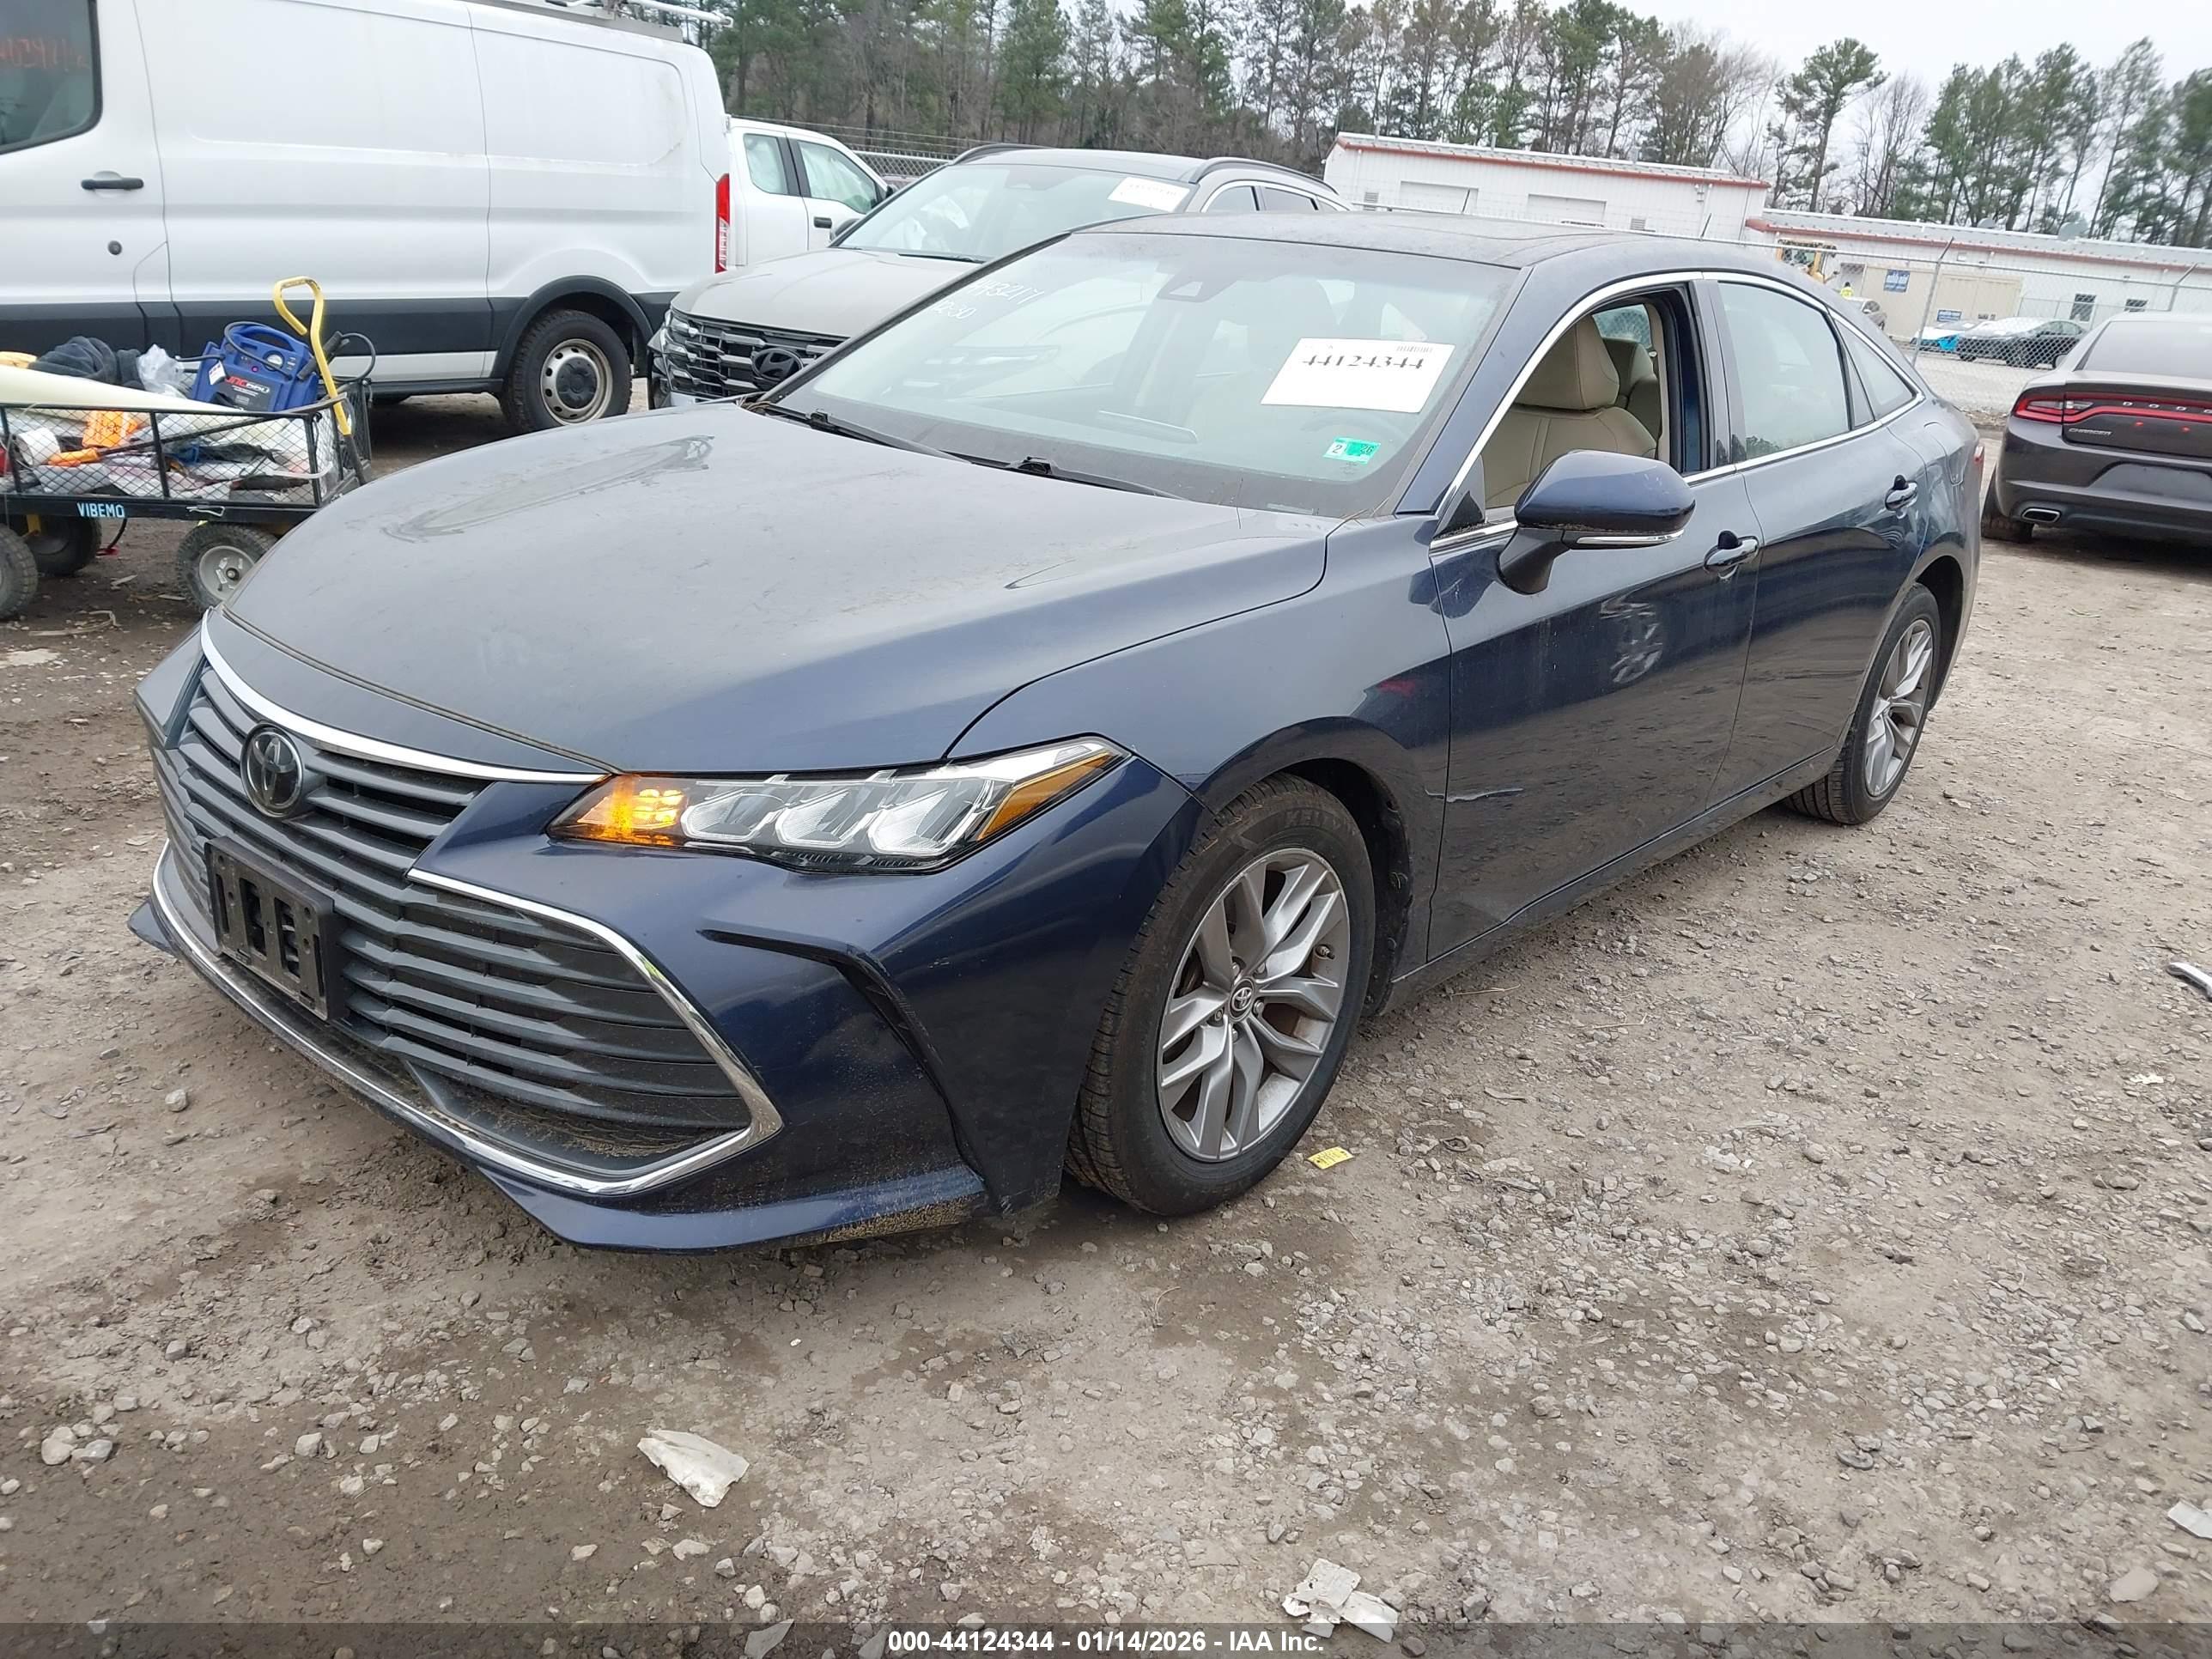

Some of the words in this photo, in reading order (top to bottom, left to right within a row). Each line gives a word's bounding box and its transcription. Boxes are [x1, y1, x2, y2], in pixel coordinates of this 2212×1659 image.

[1302, 354, 1425, 370] 44124344
[2068, 427, 2112, 436] CHARGER
[76, 501, 125, 519] VIBEMO
